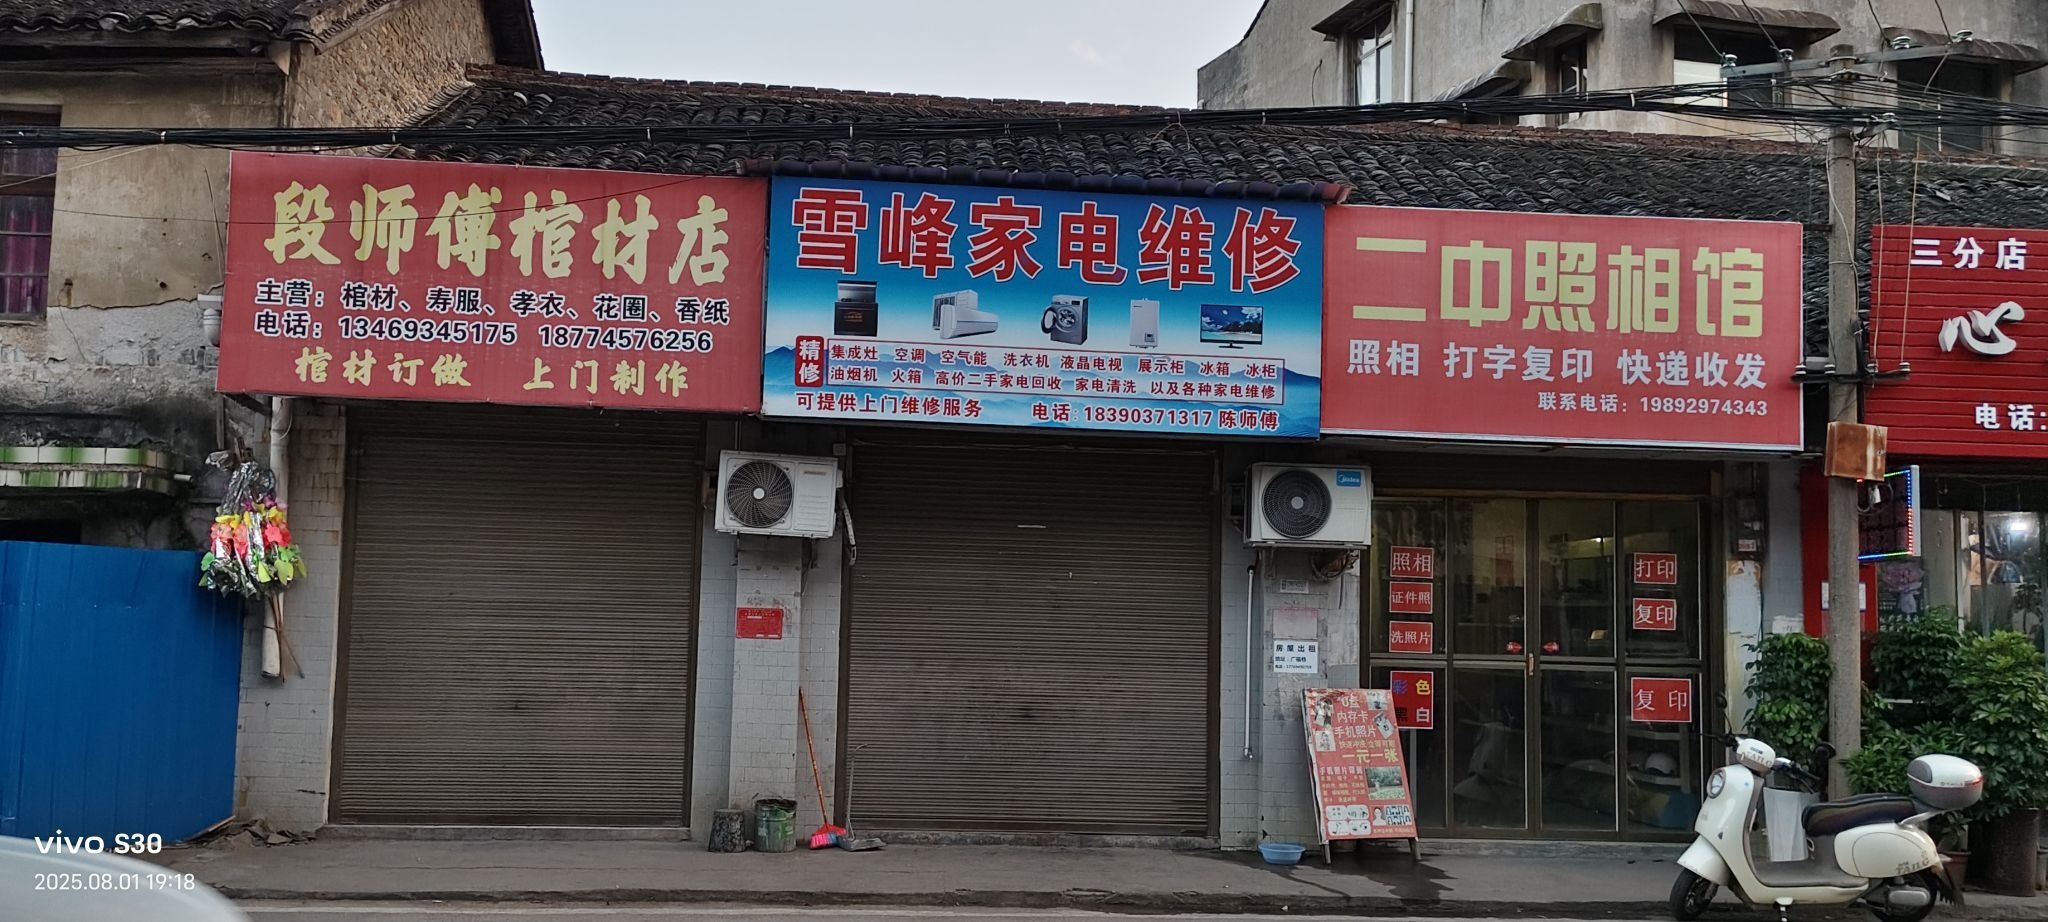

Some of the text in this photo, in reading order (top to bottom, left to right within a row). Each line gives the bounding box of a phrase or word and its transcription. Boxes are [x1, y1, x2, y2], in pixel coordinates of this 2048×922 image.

[265, 181, 730, 287] 段师傅棺材店
[792, 187, 1302, 294] 雪峰家电维修
[1910, 237, 2028, 271] 三分店
[1353, 237, 1764, 338] 二中照相馆
[539, 326, 713, 353] 18774576256
[1938, 301, 2026, 357] 心
[294, 346, 690, 398] 棺材订做 上门制作
[798, 339, 821, 384] 精修
[831, 344, 1276, 378] 集成灶 空调 空气能 洗衣机 液晶电视 展示柜 冰箱 冰柜
[1347, 339, 1768, 390] 照相 打字复印 快递收发
[830, 366, 1276, 399] 油烟机 火箱 高价二手家电回收 家电清洗 以及各种家电维修
[796, 393, 982, 417] 可提供上门维修服务
[1218, 410, 1279, 430] 陈师傅
[1392, 552, 1432, 573] 照相
[1635, 558, 1675, 580] 打印
[1391, 591, 1431, 605] 证件照
[1635, 603, 1675, 626] 复印
[1390, 630, 1431, 645] 洗照片
[1393, 679, 1431, 696] 彩色
[1634, 689, 1689, 712] 复印
[1336, 711, 1369, 723] 内存卡
[1334, 725, 1377, 739] 手机照片
[1341, 749, 1399, 764] 一元一张
